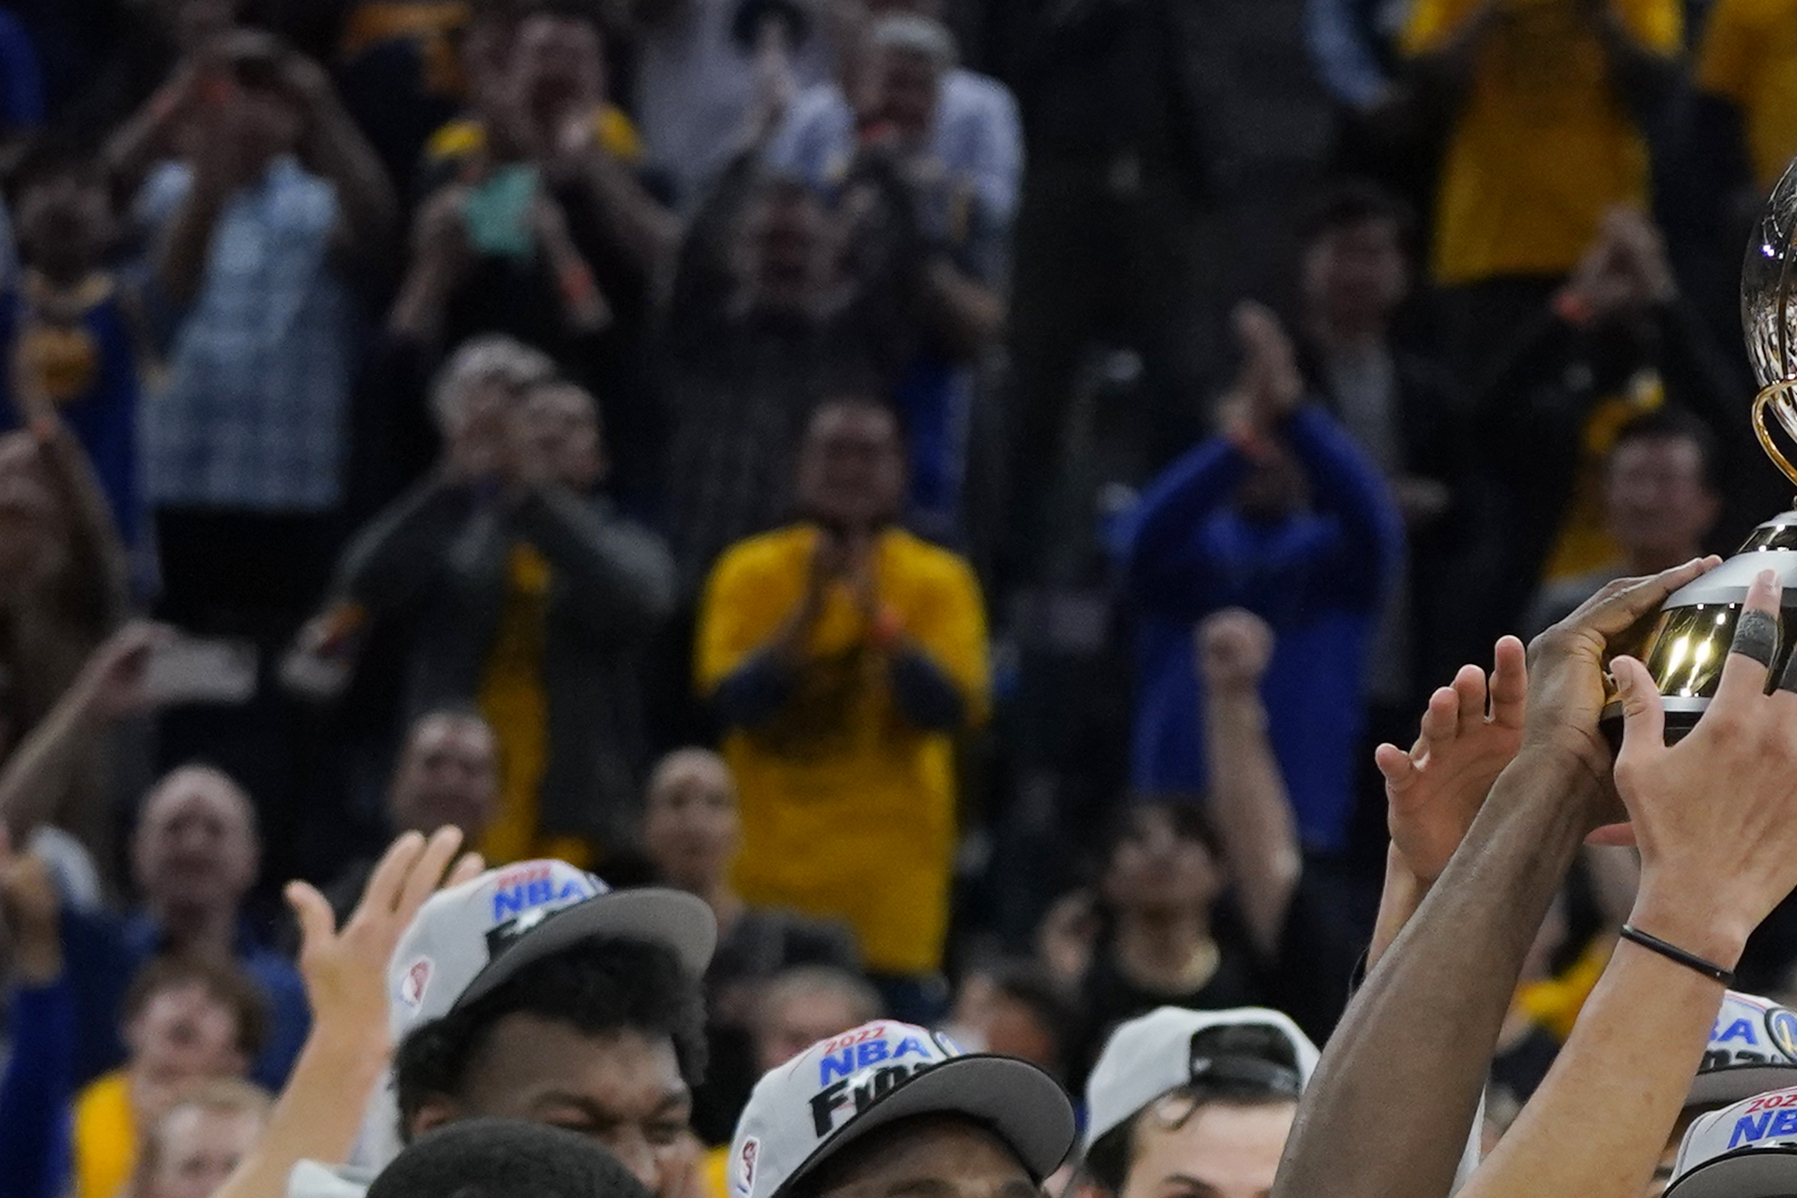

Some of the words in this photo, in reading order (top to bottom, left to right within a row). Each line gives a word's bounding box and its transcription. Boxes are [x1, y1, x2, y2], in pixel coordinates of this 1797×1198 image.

[493, 878, 589, 923] NBA
[819, 1036, 932, 1088] NBA
[824, 1026, 887, 1056] 2022
